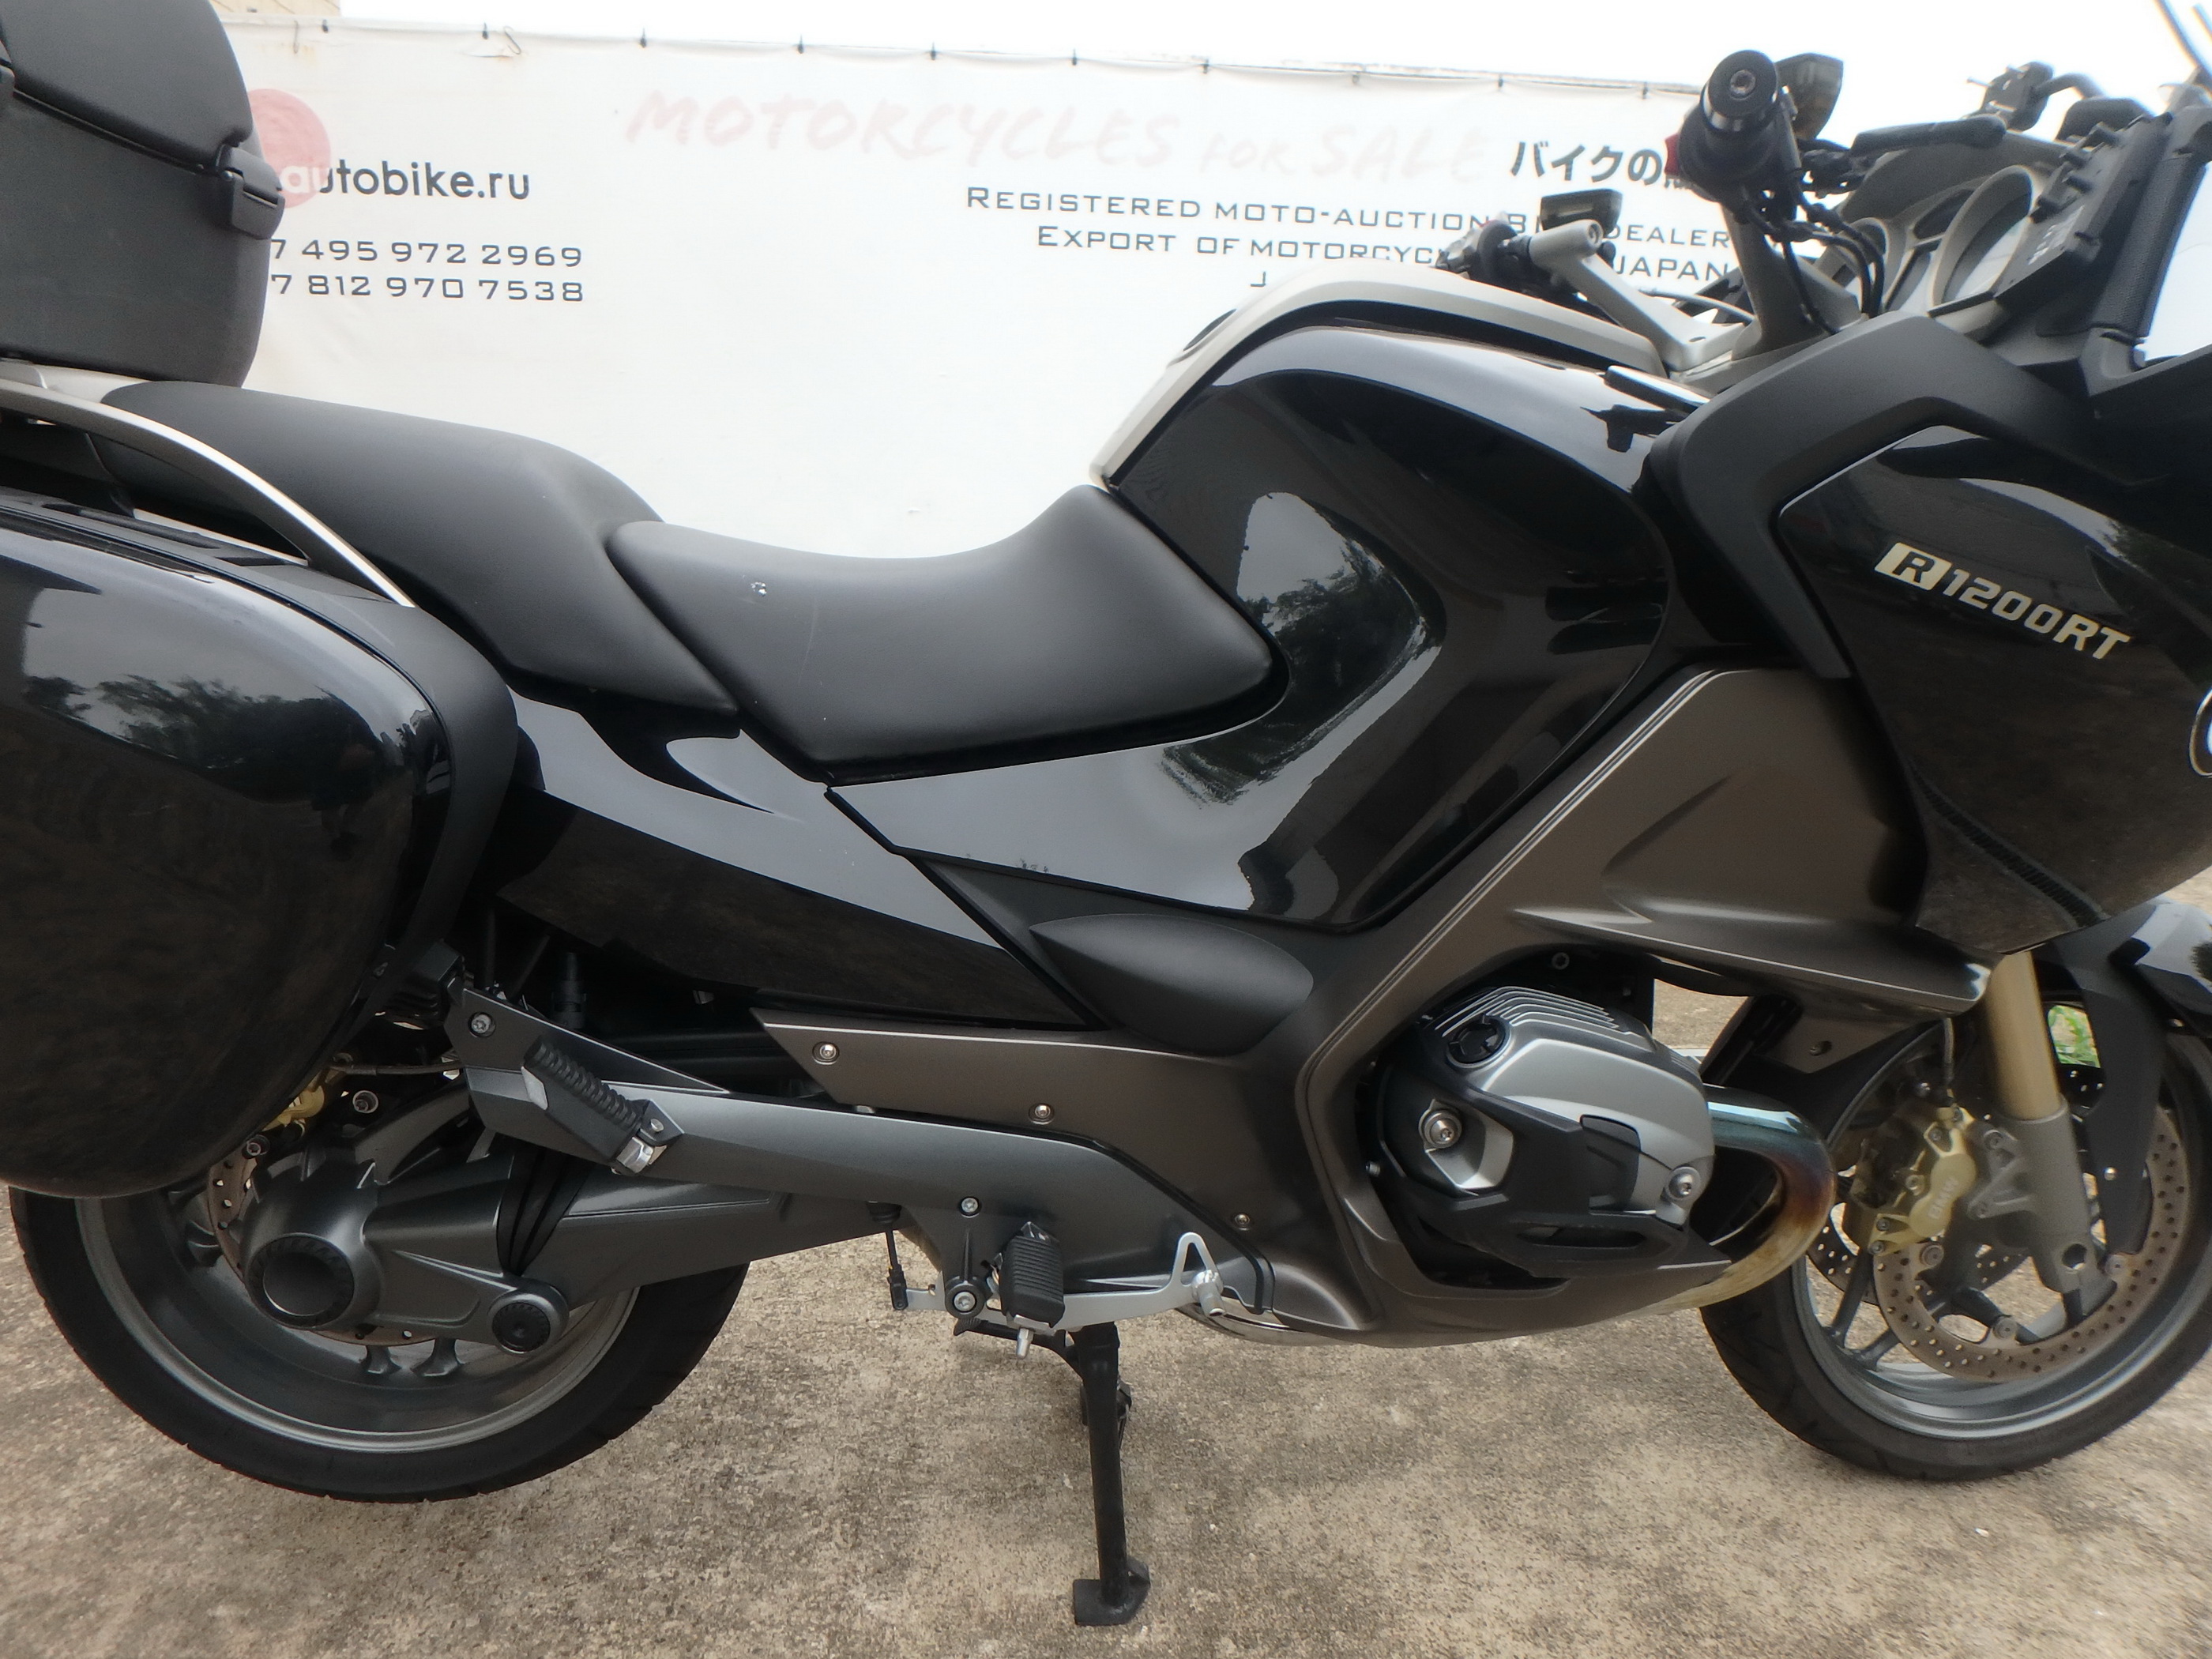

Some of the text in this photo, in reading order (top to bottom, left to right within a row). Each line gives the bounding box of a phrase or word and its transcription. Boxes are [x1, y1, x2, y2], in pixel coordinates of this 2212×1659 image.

[625, 90, 1180, 167] MOTORCYCLES
[1311, 117, 1492, 184] SALE
[1510, 141, 1690, 190] バイクの
[302, 240, 378, 261] 495
[391, 243, 467, 263] 972
[481, 245, 581, 267] 2969
[1196, 237, 1241, 254] OF
[308, 275, 371, 295] 812
[386, 277, 464, 298] 970
[479, 280, 583, 302] 7538
